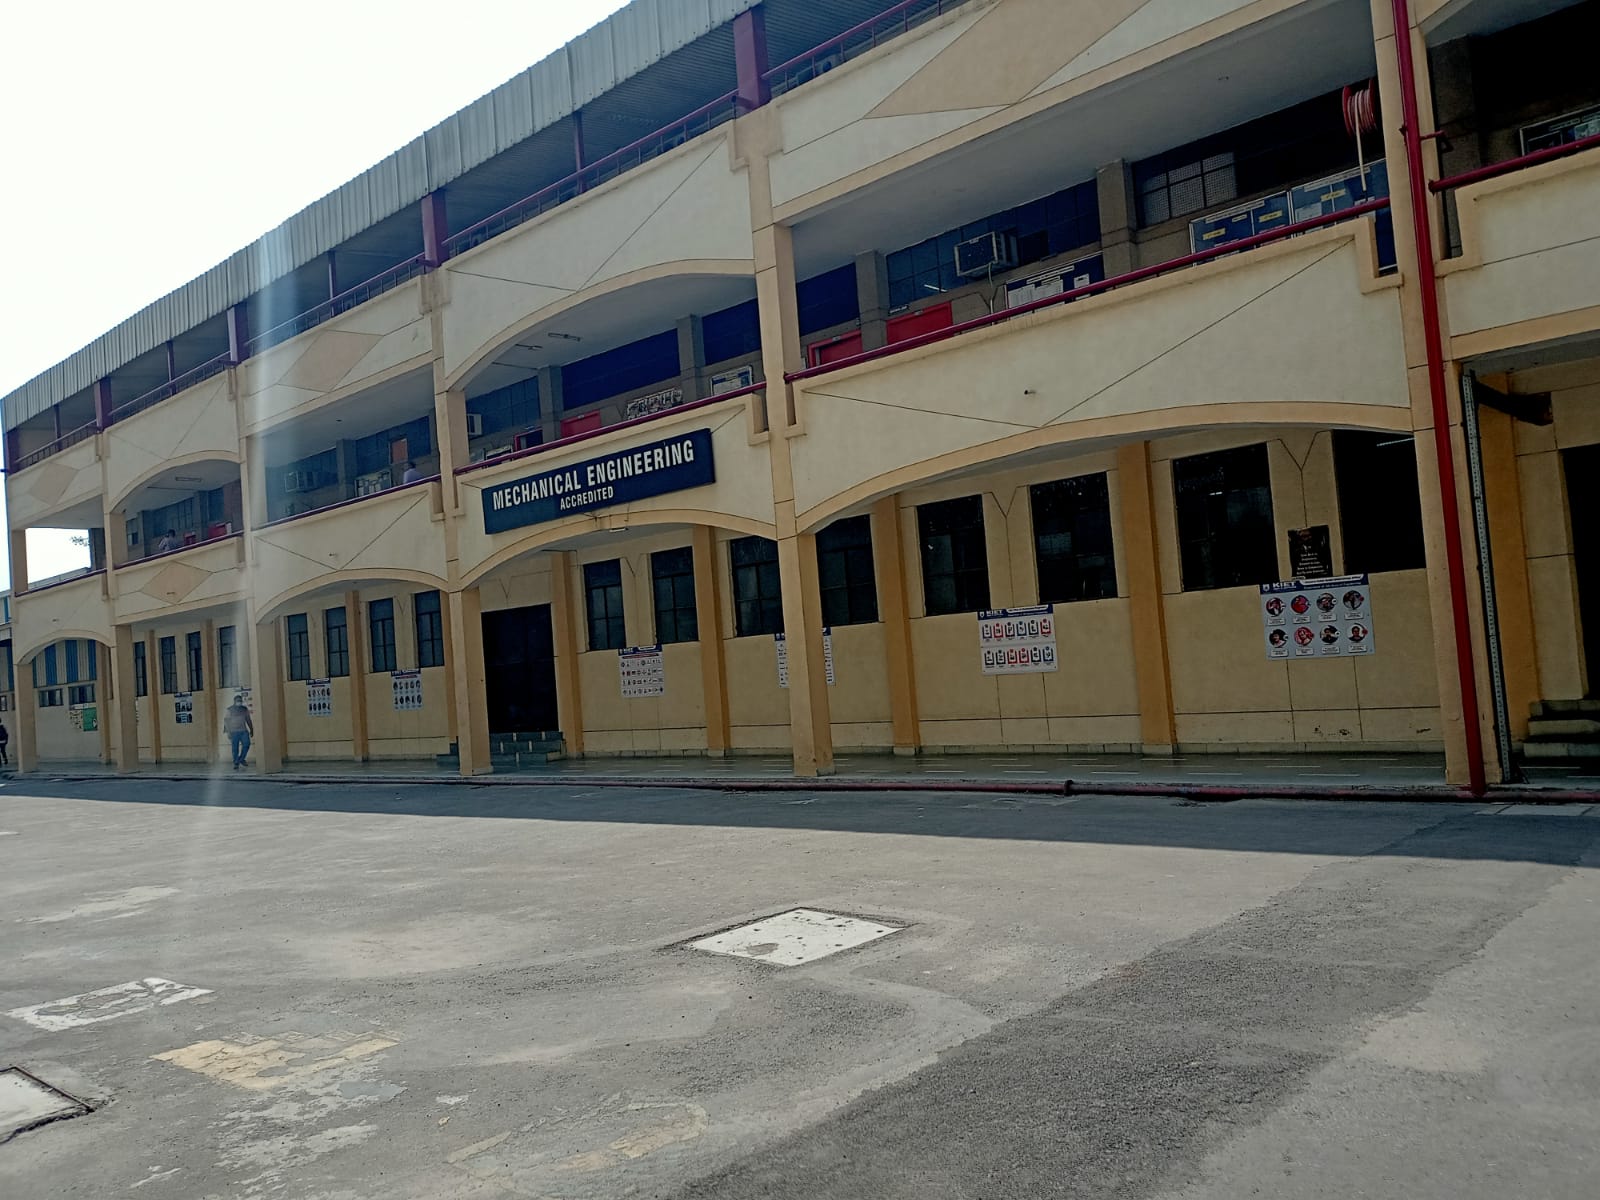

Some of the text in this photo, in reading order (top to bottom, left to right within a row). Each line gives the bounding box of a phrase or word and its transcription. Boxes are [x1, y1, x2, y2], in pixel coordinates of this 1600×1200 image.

[493, 440, 694, 511] MECHANICAL ENGINEERING
[560, 486, 614, 511] ACCREDITED
